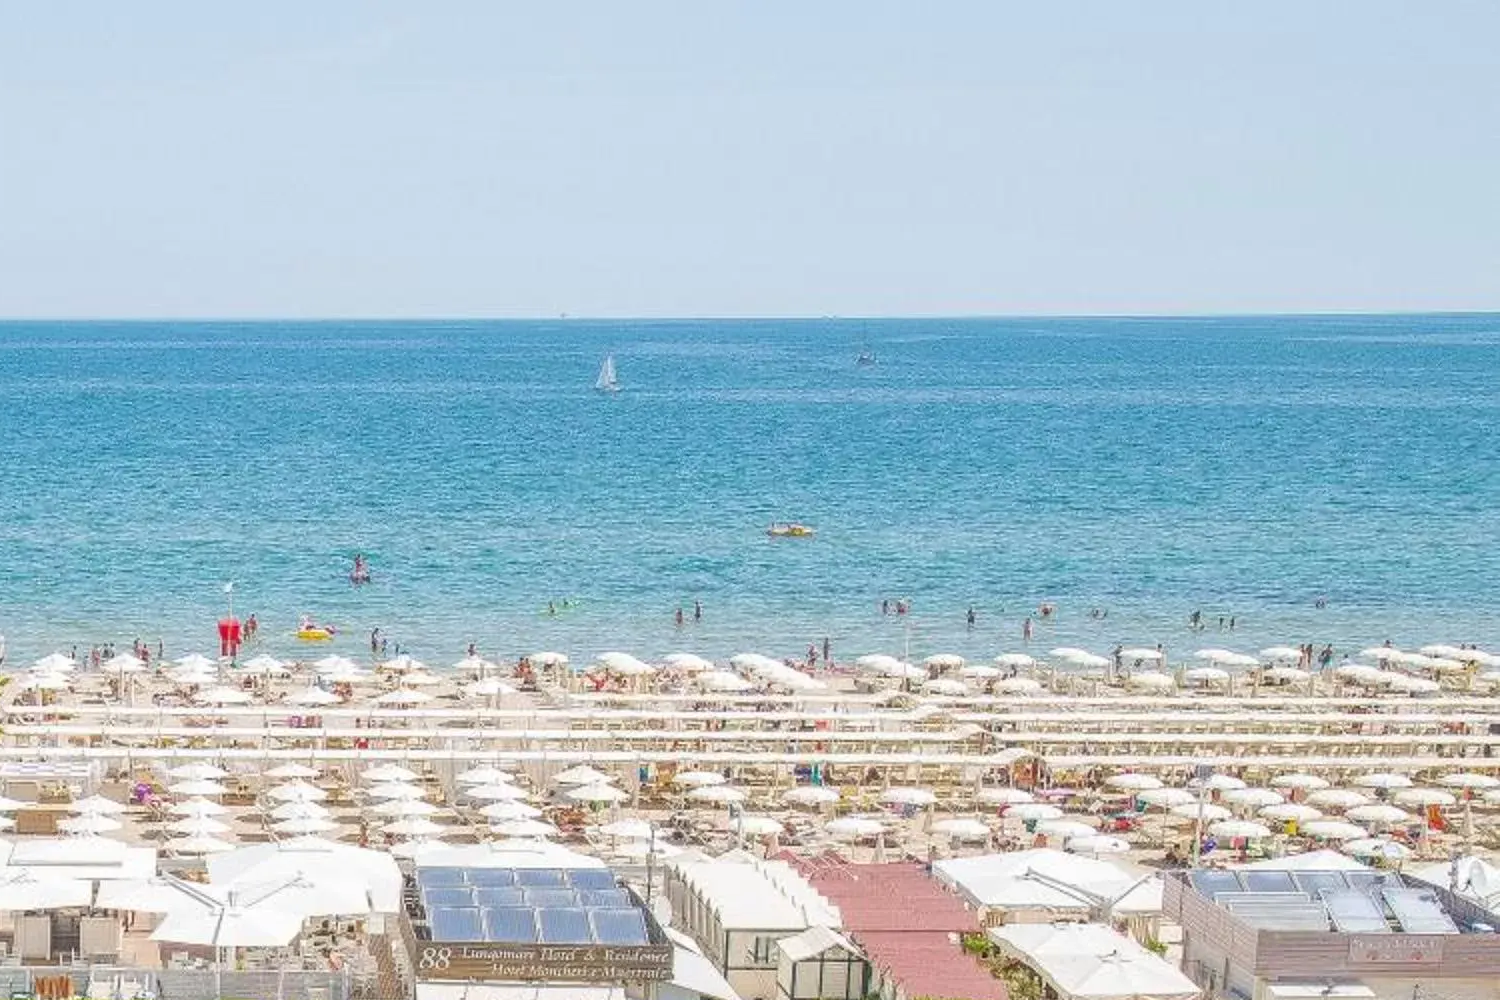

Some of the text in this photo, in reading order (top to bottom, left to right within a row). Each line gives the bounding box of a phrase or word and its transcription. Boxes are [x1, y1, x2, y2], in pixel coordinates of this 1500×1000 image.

[419, 947, 452, 971] 88
[540, 947, 576, 961] Hotel
[583, 949, 595, 961] &
[605, 948, 669, 962] Residence
[491, 963, 526, 977] Hotel
